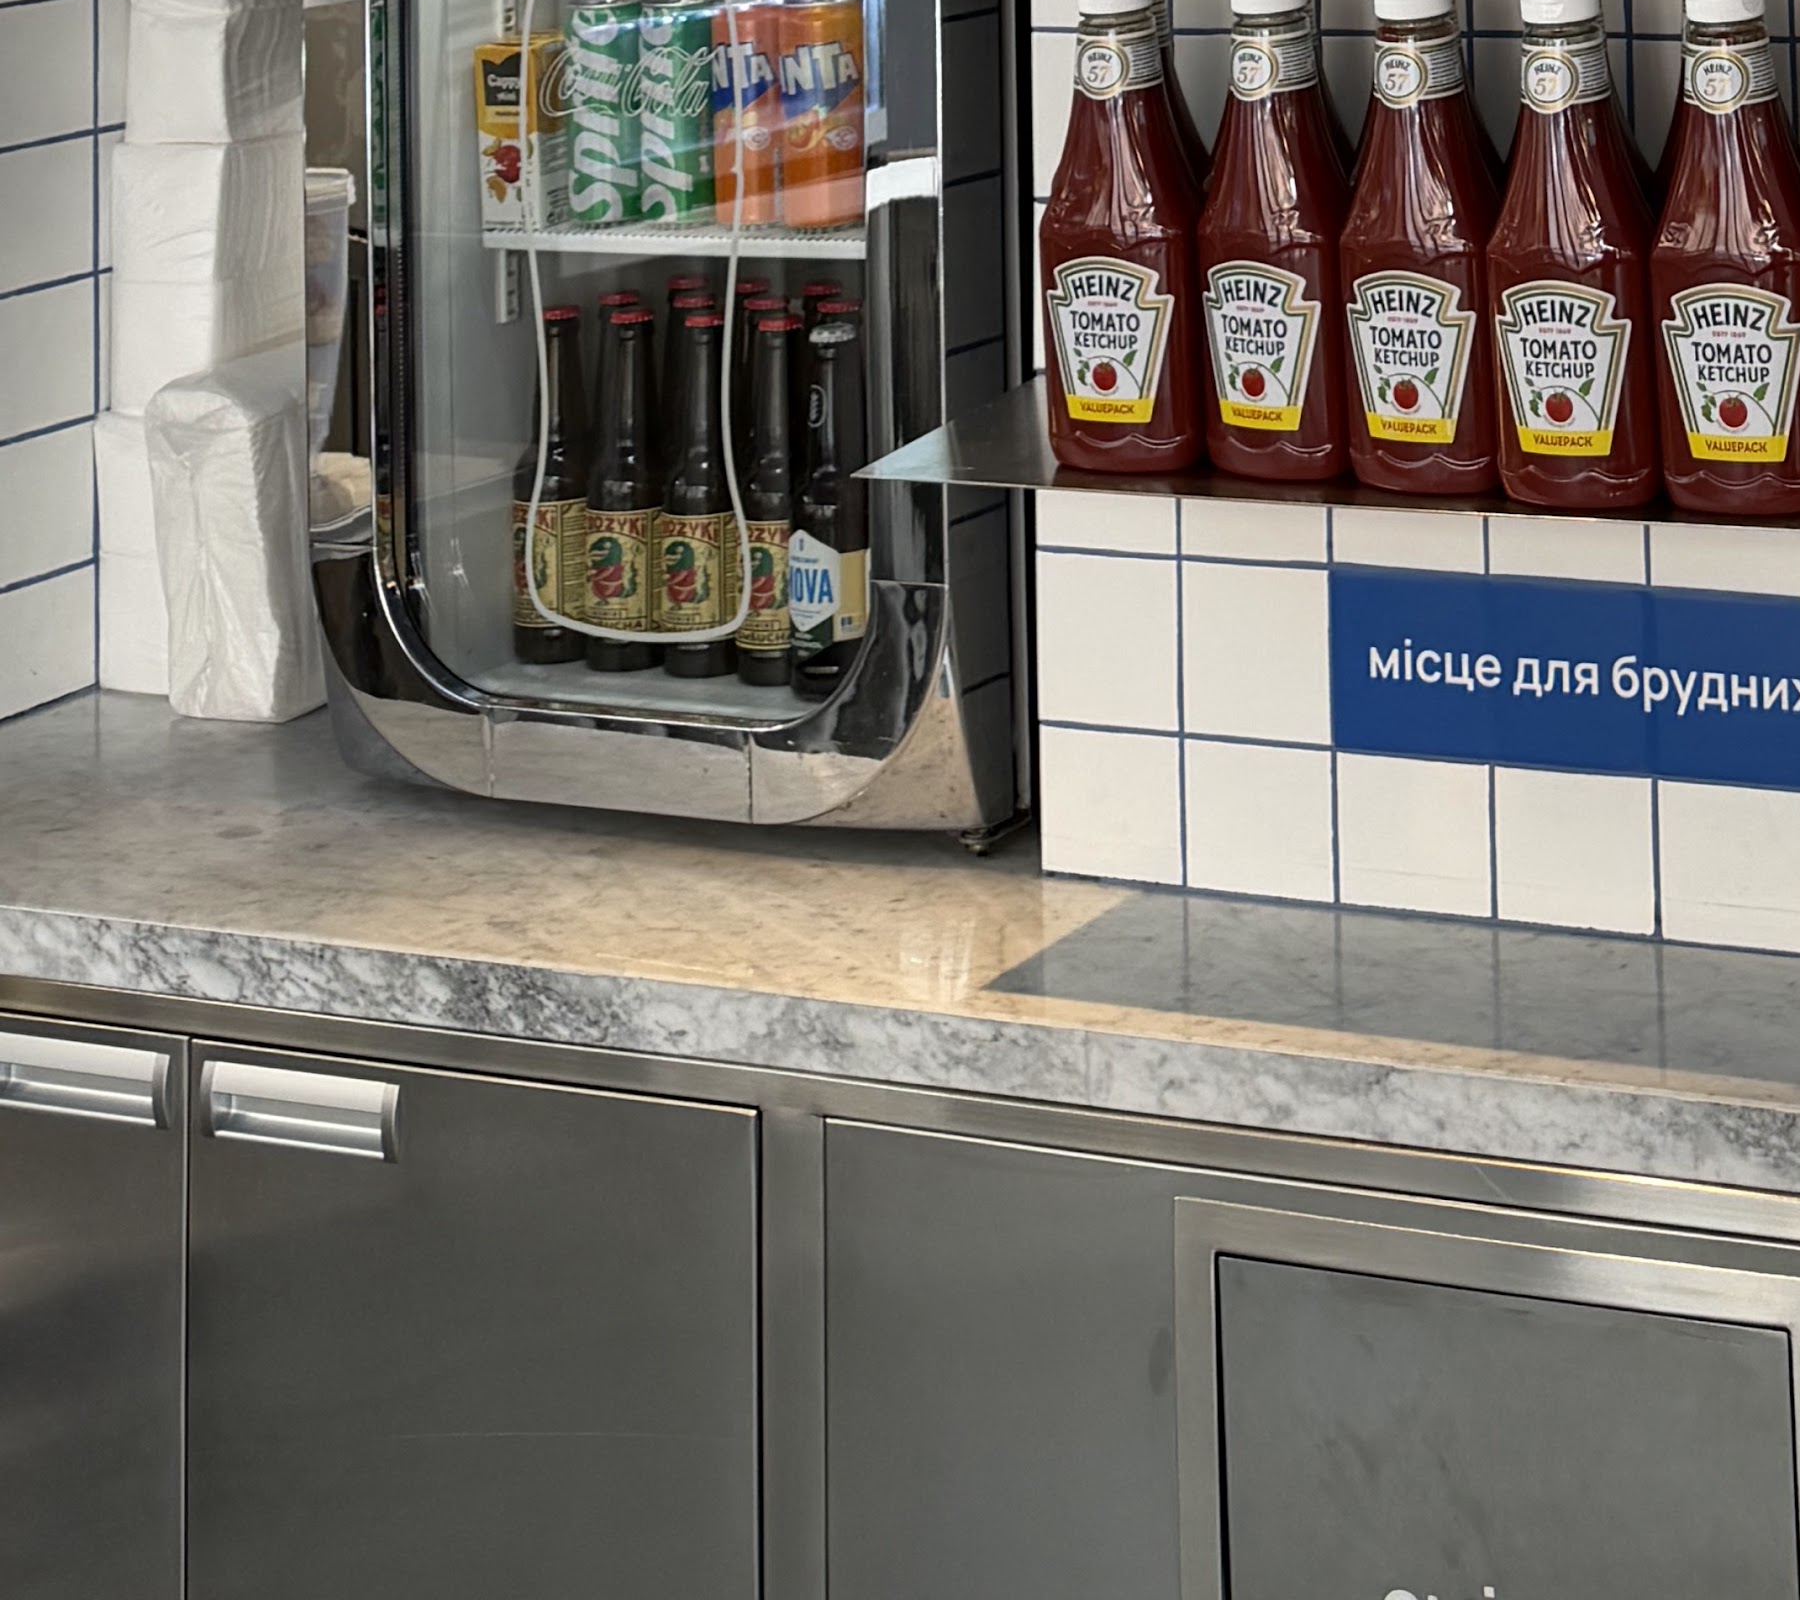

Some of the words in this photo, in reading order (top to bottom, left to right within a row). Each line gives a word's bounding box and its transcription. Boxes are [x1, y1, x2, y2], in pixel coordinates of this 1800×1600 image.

[779, 43, 859, 95] NTA
[1071, 274, 1135, 302] HEINZ
[1370, 289, 1436, 318] HEINZ
[1520, 300, 1590, 328] HEINZ
[1069, 310, 1140, 332] TOMATO
[1692, 302, 1766, 332] HEINZ
[1074, 332, 1138, 350] KETCHUP
[1369, 325, 1442, 350] TOMATO
[1520, 337, 1597, 360] TOMATO
[1374, 348, 1440, 367] KETCHUP
[1691, 341, 1772, 364] TOMATO
[1526, 360, 1595, 379] KETCHUP
[1698, 364, 1770, 383] KETCHUP
[1370, 639, 1501, 691] місце
[1513, 658, 1598, 697] для
